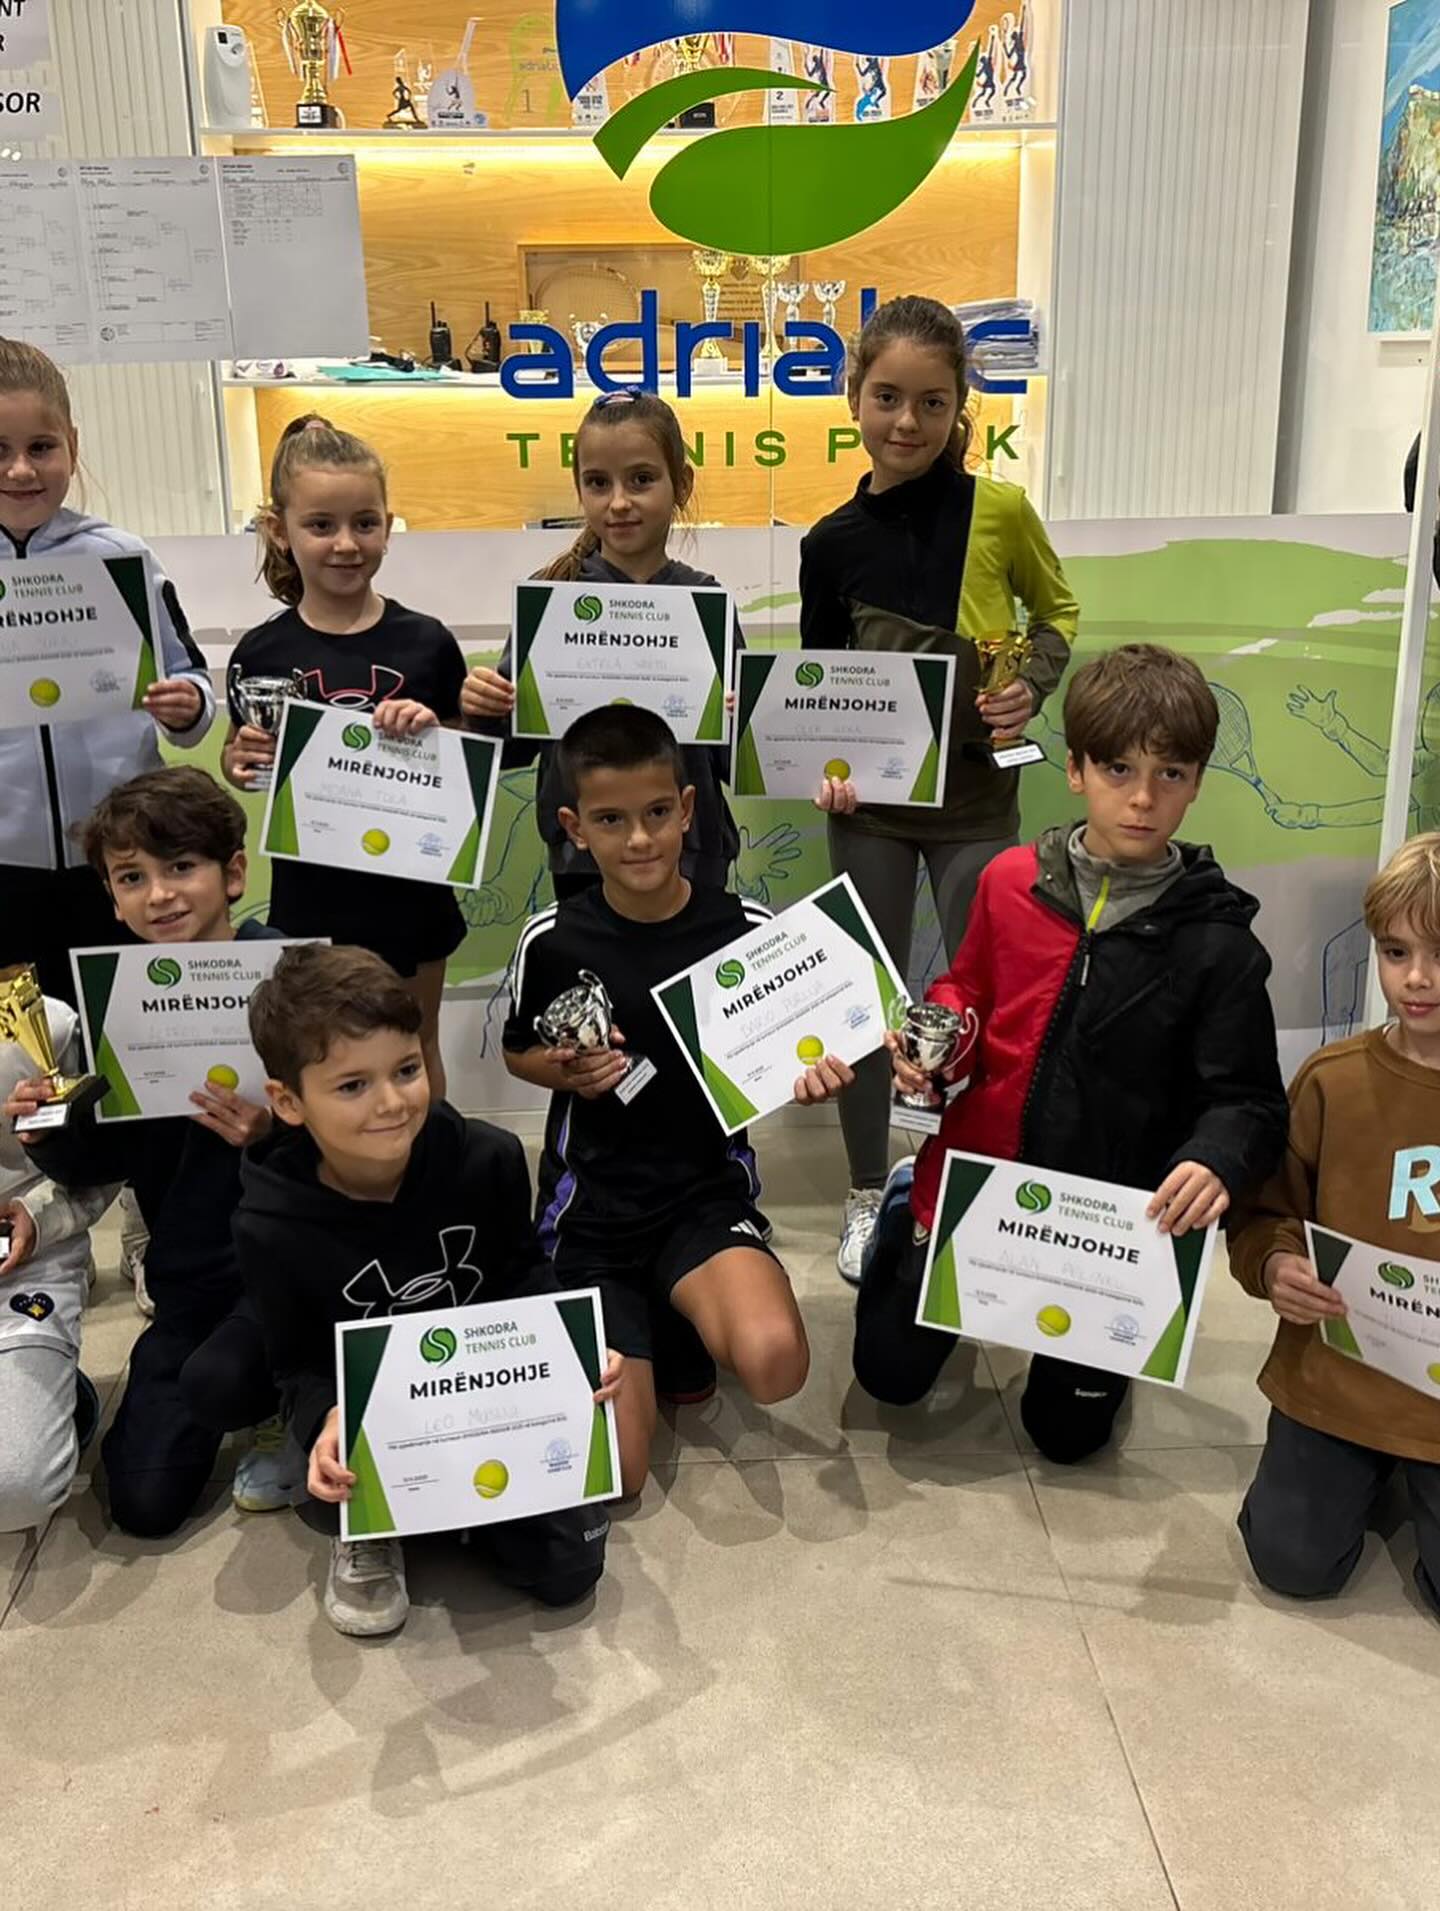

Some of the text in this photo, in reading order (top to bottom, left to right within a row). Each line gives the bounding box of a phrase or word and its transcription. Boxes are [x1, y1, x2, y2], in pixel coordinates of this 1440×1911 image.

[506, 424, 1020, 469] TENIS PK
[609, 599, 656, 609] SHKODRA
[608, 611, 671, 622] TENNIS CLUB
[563, 630, 679, 648] MIRËNJOHJE
[830, 665, 876, 675] SHKODRA
[829, 676, 890, 687] TENNIS CLUB
[784, 695, 898, 713] MIRËNJOHJE
[327, 756, 443, 789] MIRËNJOHJE
[745, 931, 789, 961] SHKODRA
[751, 932, 807, 971] TENNIS CLUB
[187, 958, 242, 970] SHKODRA
[191, 970, 262, 982] TENNIS CLUB
[722, 947, 828, 1020] MIRËNJOHJE
[142, 993, 250, 1013] MIRËNJOH
[1059, 1191, 1118, 1215] SHKODRA
[1058, 1205, 1134, 1232] TENNIS CLUB
[997, 1217, 1141, 1265] MIRËNJOHJE
[463, 1320, 519, 1340] SHKODRA
[464, 1333, 537, 1355] TENNIS CLUB
[409, 1361, 551, 1401] MIRËNJOHJE
